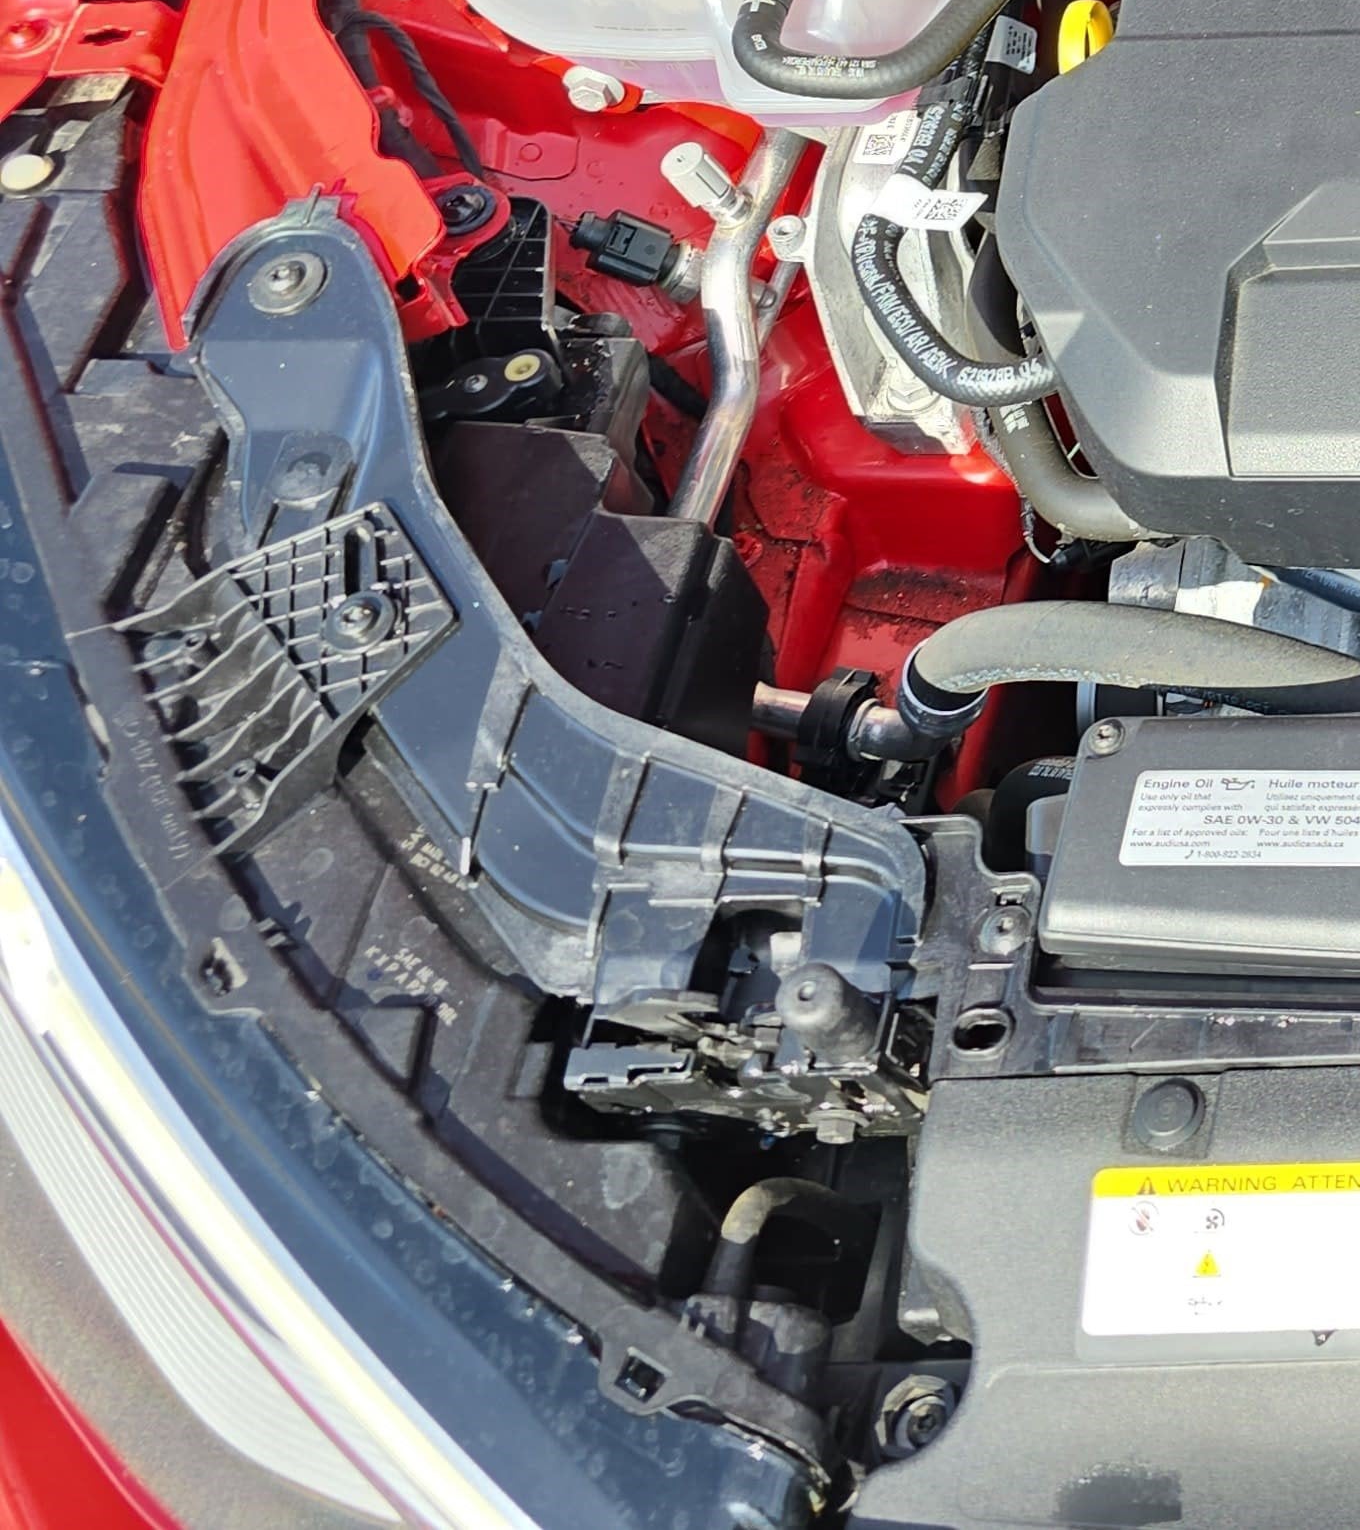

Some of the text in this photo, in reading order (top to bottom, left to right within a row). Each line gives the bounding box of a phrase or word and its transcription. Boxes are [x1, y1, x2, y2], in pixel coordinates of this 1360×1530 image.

[1143, 778, 1214, 790] Engine Oil
[1268, 778, 1360, 789] Huile moteur
[1140, 792, 1213, 802] Use only oil that
[1265, 792, 1298, 802] Utilisez
[1300, 793, 1355, 803] uniquement
[1138, 803, 1244, 813] expressly complies with
[1264, 804, 1279, 813] qui
[1281, 803, 1316, 812] satisfait
[1203, 815, 1234, 825] SAE
[1236, 815, 1284, 825] 0W-30
[1287, 815, 1300, 825] &
[1305, 815, 1332, 825] VW
[1131, 829, 1148, 837] For
[1156, 829, 1172, 837] list
[1172, 829, 1184, 837] of
[1185, 829, 1228, 839] approved
[1258, 829, 1280, 837] Pour
[1301, 829, 1321, 837] liste
[1129, 840, 1211, 848] www.audiusa.com
[1256, 840, 1345, 848] www.audicanada.ca
[1167, 1176, 1278, 1193] WARNING
